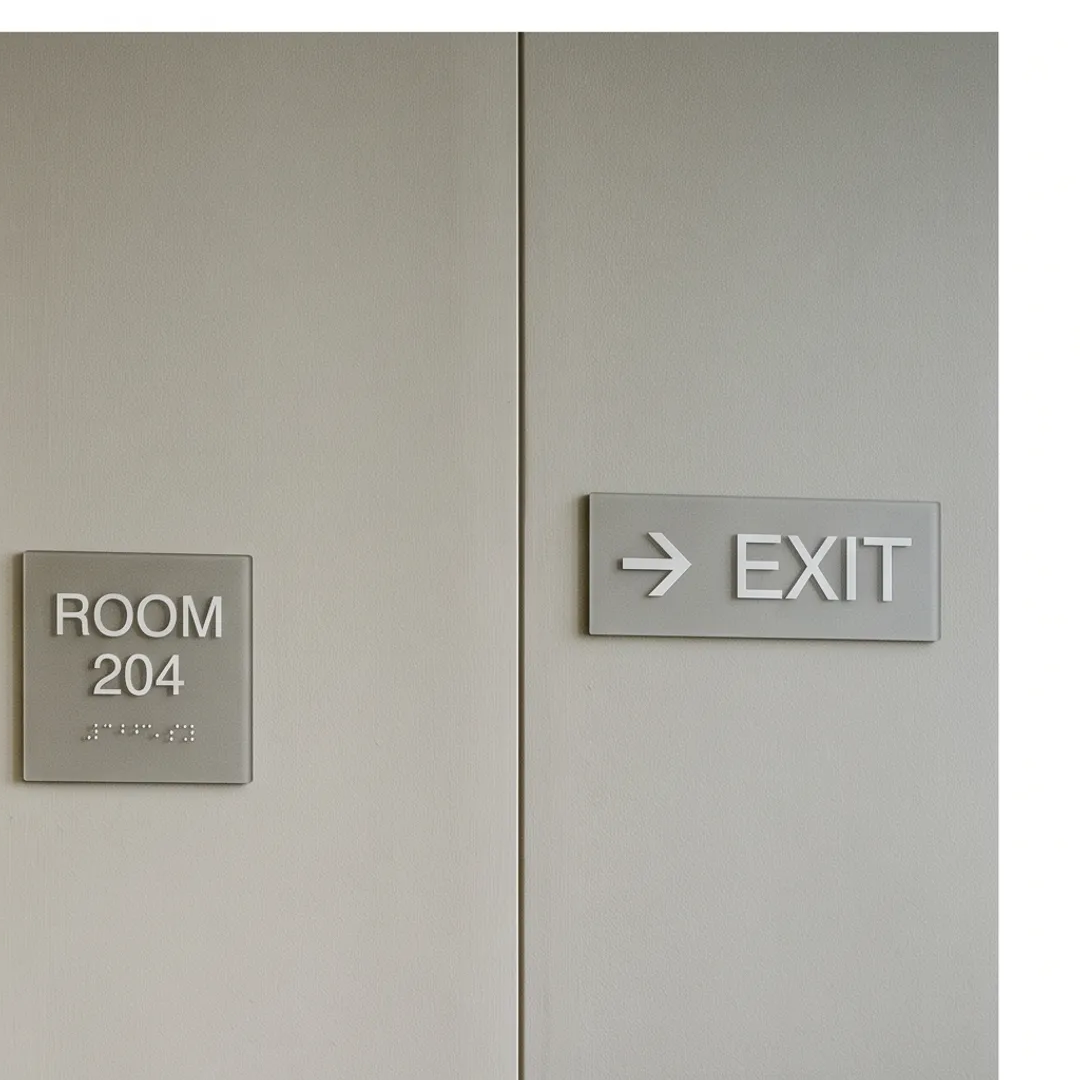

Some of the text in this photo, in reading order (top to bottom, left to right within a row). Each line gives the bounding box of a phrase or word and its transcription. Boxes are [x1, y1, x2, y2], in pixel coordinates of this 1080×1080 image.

[737, 534, 912, 602] EXIT
[56, 592, 222, 638] ROOM
[93, 653, 185, 696] 204
